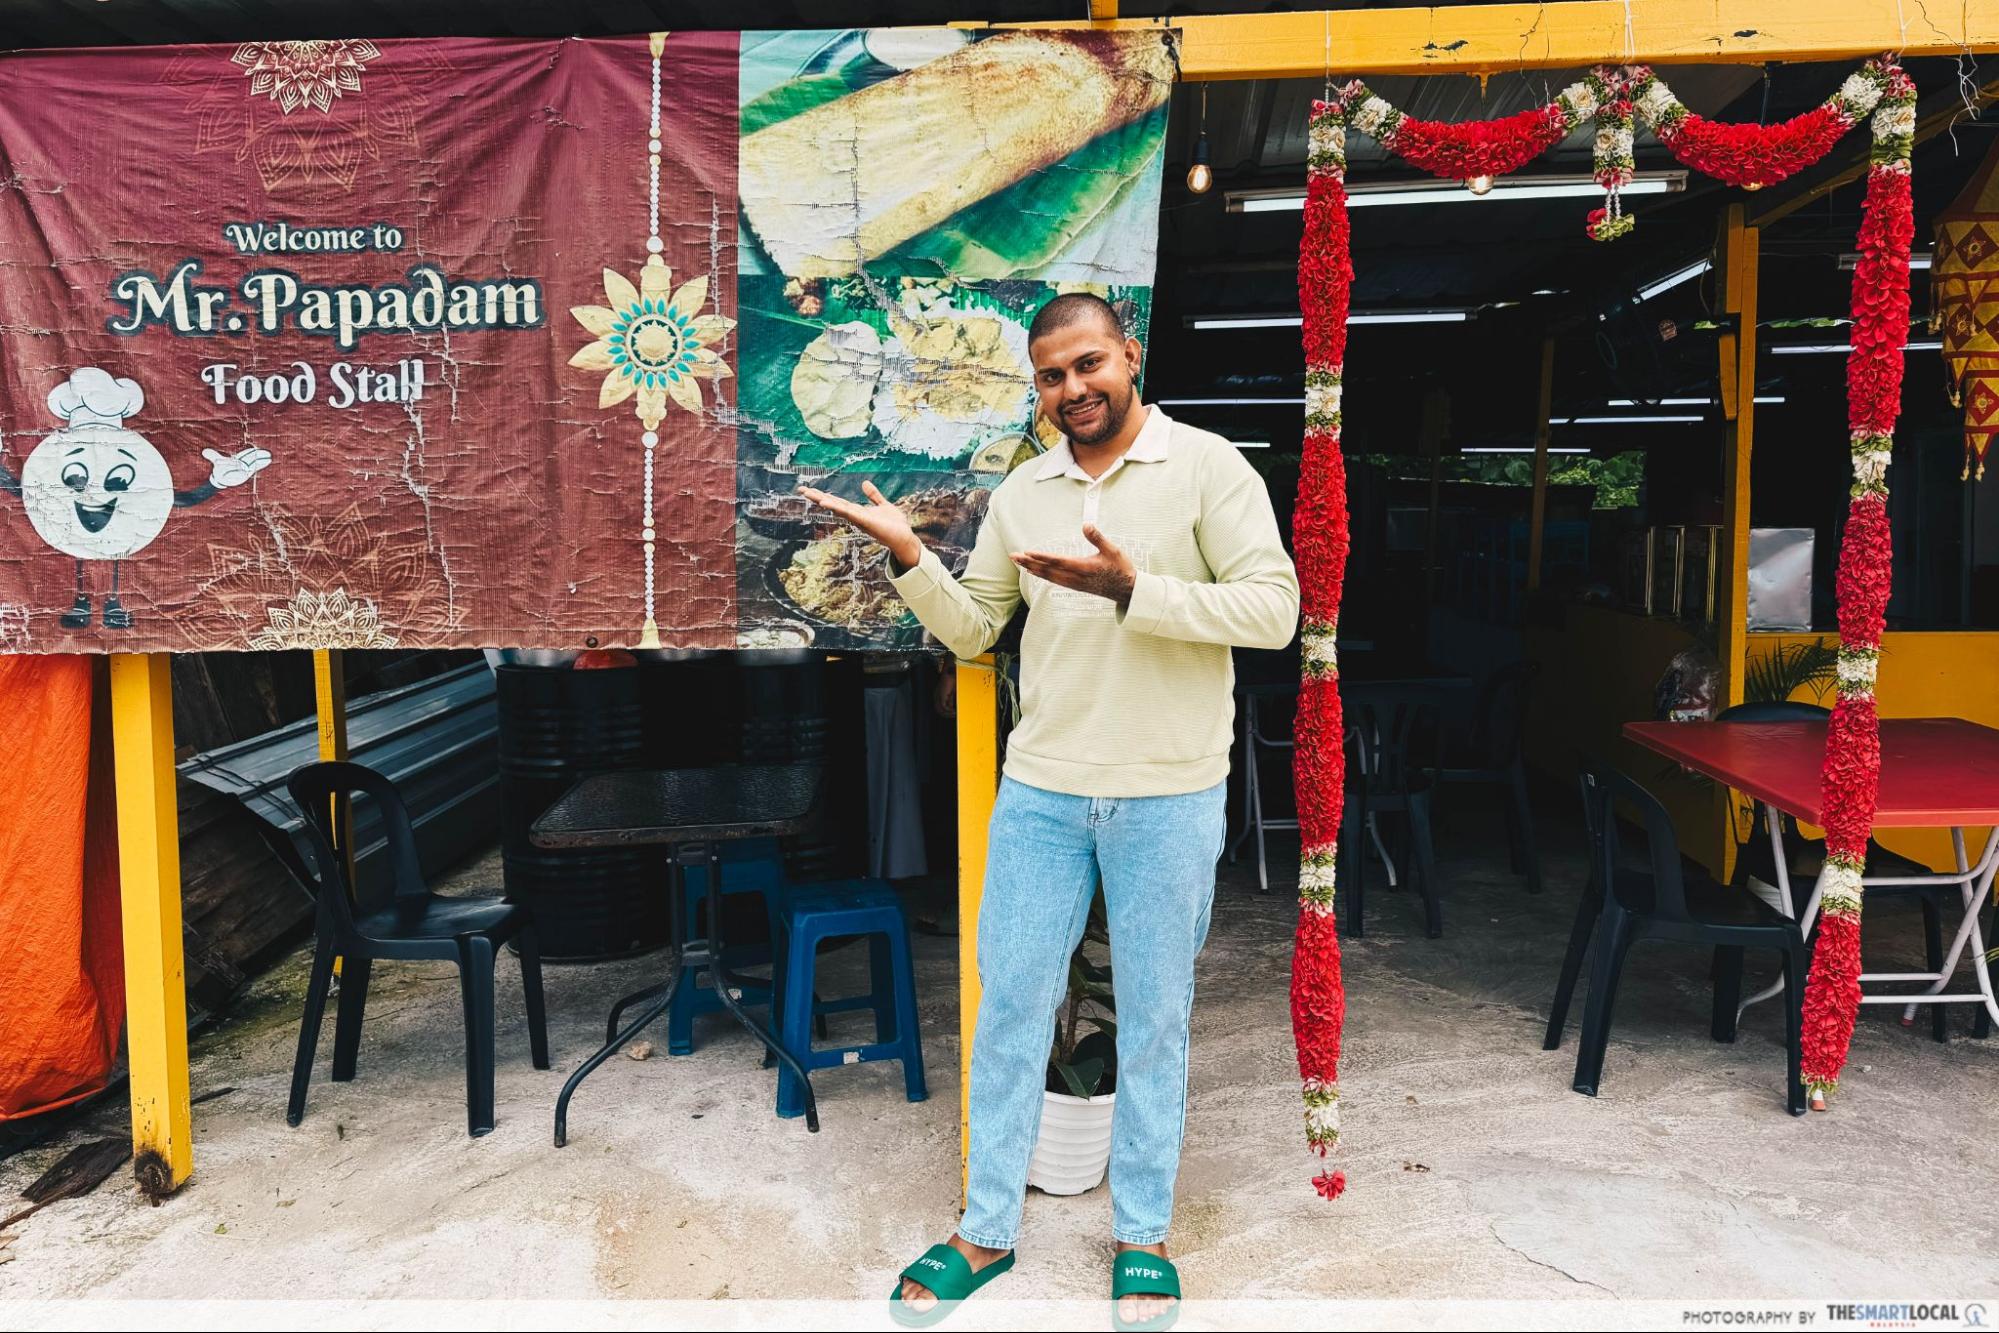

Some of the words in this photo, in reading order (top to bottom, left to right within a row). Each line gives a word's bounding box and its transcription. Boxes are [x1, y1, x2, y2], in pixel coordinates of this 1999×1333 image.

[226, 223, 365, 252] Welcome
[374, 224, 402, 249] to
[201, 361, 316, 405] Food
[328, 358, 423, 409] Stall
